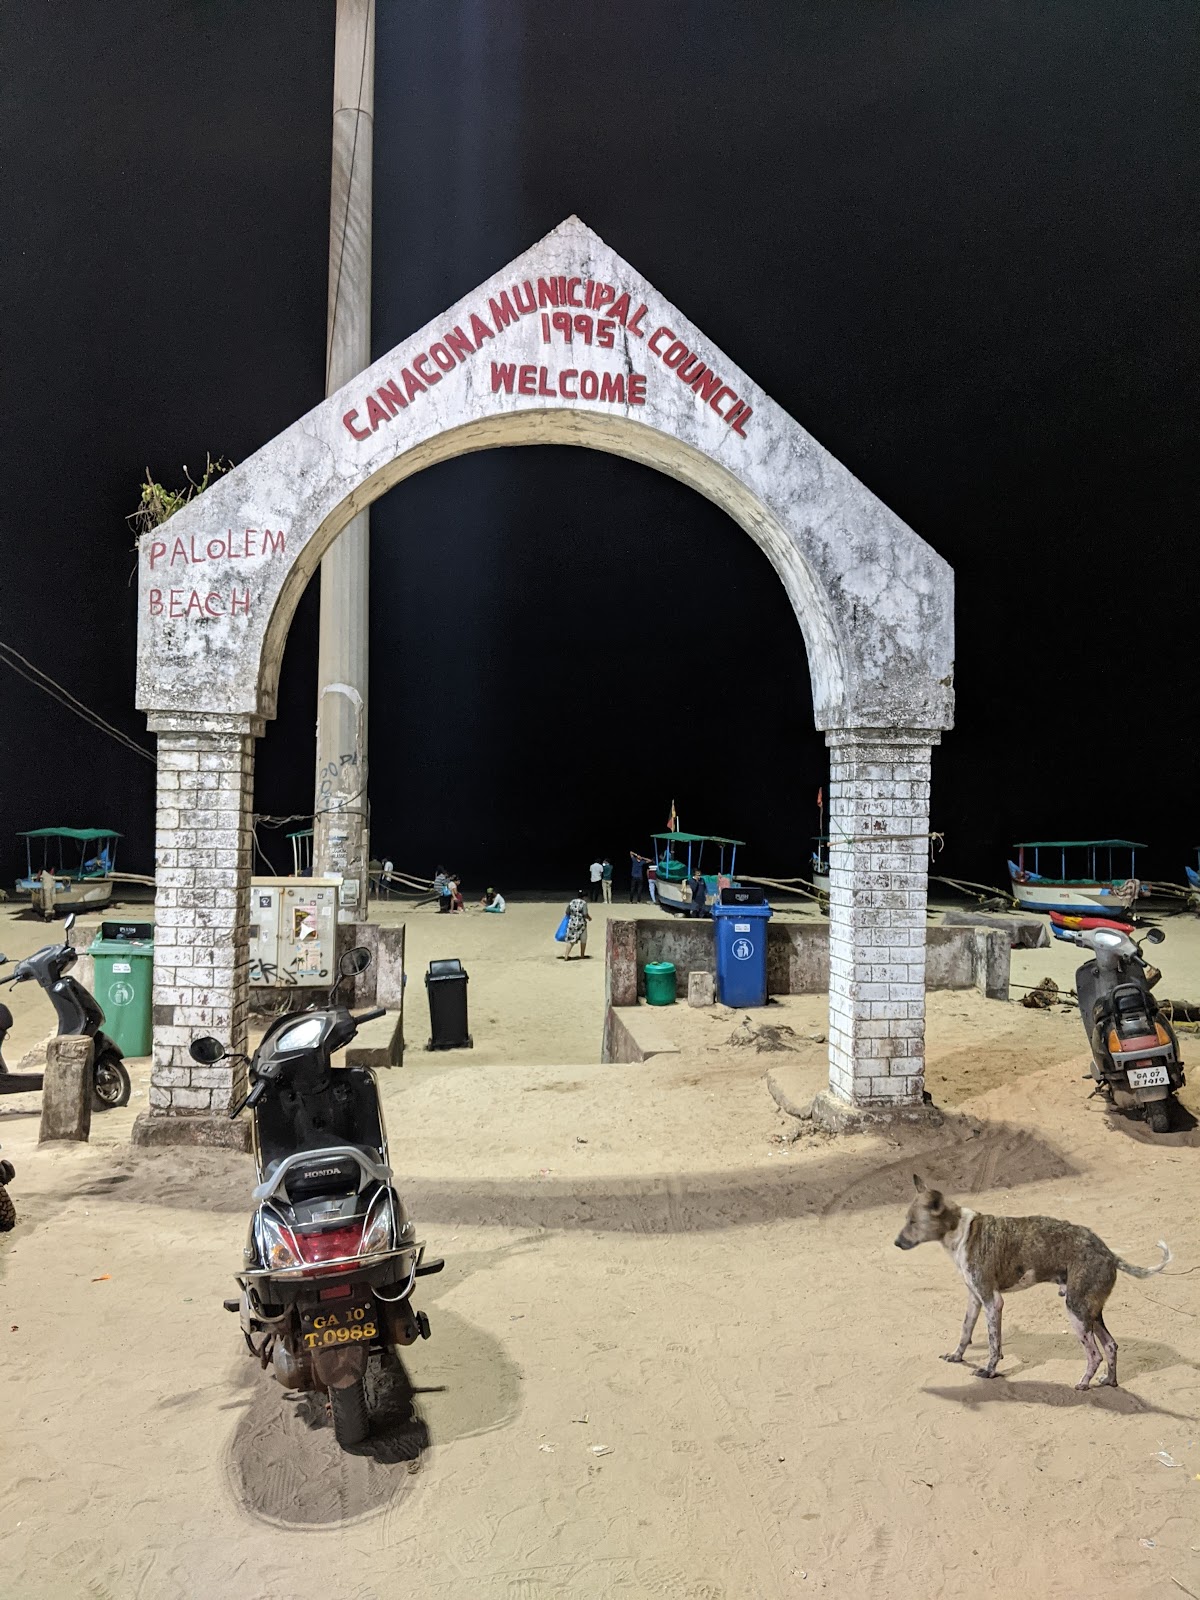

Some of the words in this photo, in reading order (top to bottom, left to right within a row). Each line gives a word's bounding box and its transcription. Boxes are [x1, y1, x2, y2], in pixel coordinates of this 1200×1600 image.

[541, 311, 616, 349] 1995
[343, 313, 495, 441] CANACONA
[488, 275, 649, 339] MUNICIPAL
[647, 326, 754, 440] COUNCIL
[490, 361, 648, 405] WELCOME
[150, 529, 286, 570] PALOLEM
[149, 587, 251, 618] BEACH
[1136, 1072, 1148, 1080] GA
[1150, 1070, 1160, 1078] 07
[304, 1167, 342, 1179] HONDA
[313, 1314, 340, 1329] GA
[345, 1308, 365, 1322] 10
[303, 1322, 377, 1348] T.0988
